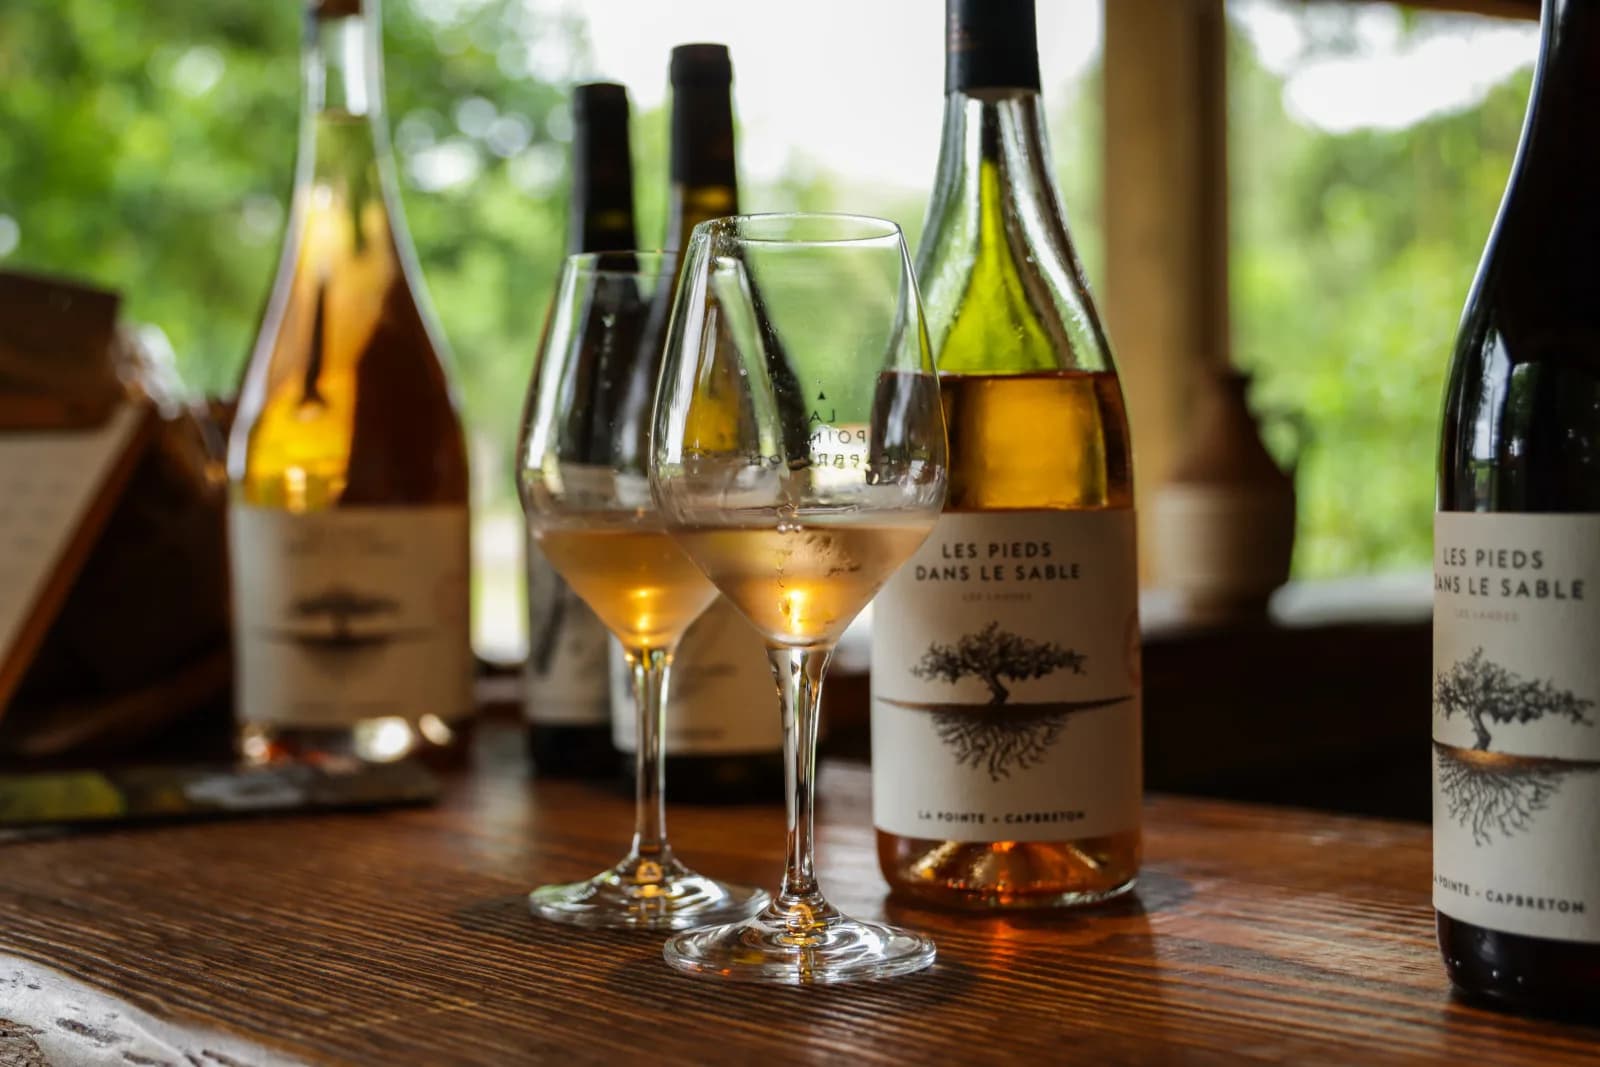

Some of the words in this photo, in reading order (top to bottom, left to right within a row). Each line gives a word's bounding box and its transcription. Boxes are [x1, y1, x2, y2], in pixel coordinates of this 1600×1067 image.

[942, 542, 978, 559] LES
[988, 541, 1053, 559] PIEDS
[1442, 547, 1467, 566] LES
[1475, 549, 1544, 569] PIEDS
[915, 565, 970, 581] DANS
[980, 565, 1005, 581] LE
[1015, 564, 1081, 581] SABLE
[1468, 576, 1490, 596] LE
[1501, 578, 1585, 600] SABLE
[918, 810, 932, 820] LA
[937, 811, 986, 824] POINTE
[1004, 811, 1086, 824] CAPBRETON
[1438, 876, 1470, 897] POINTE
[1485, 889, 1586, 914] CAPBRETON
